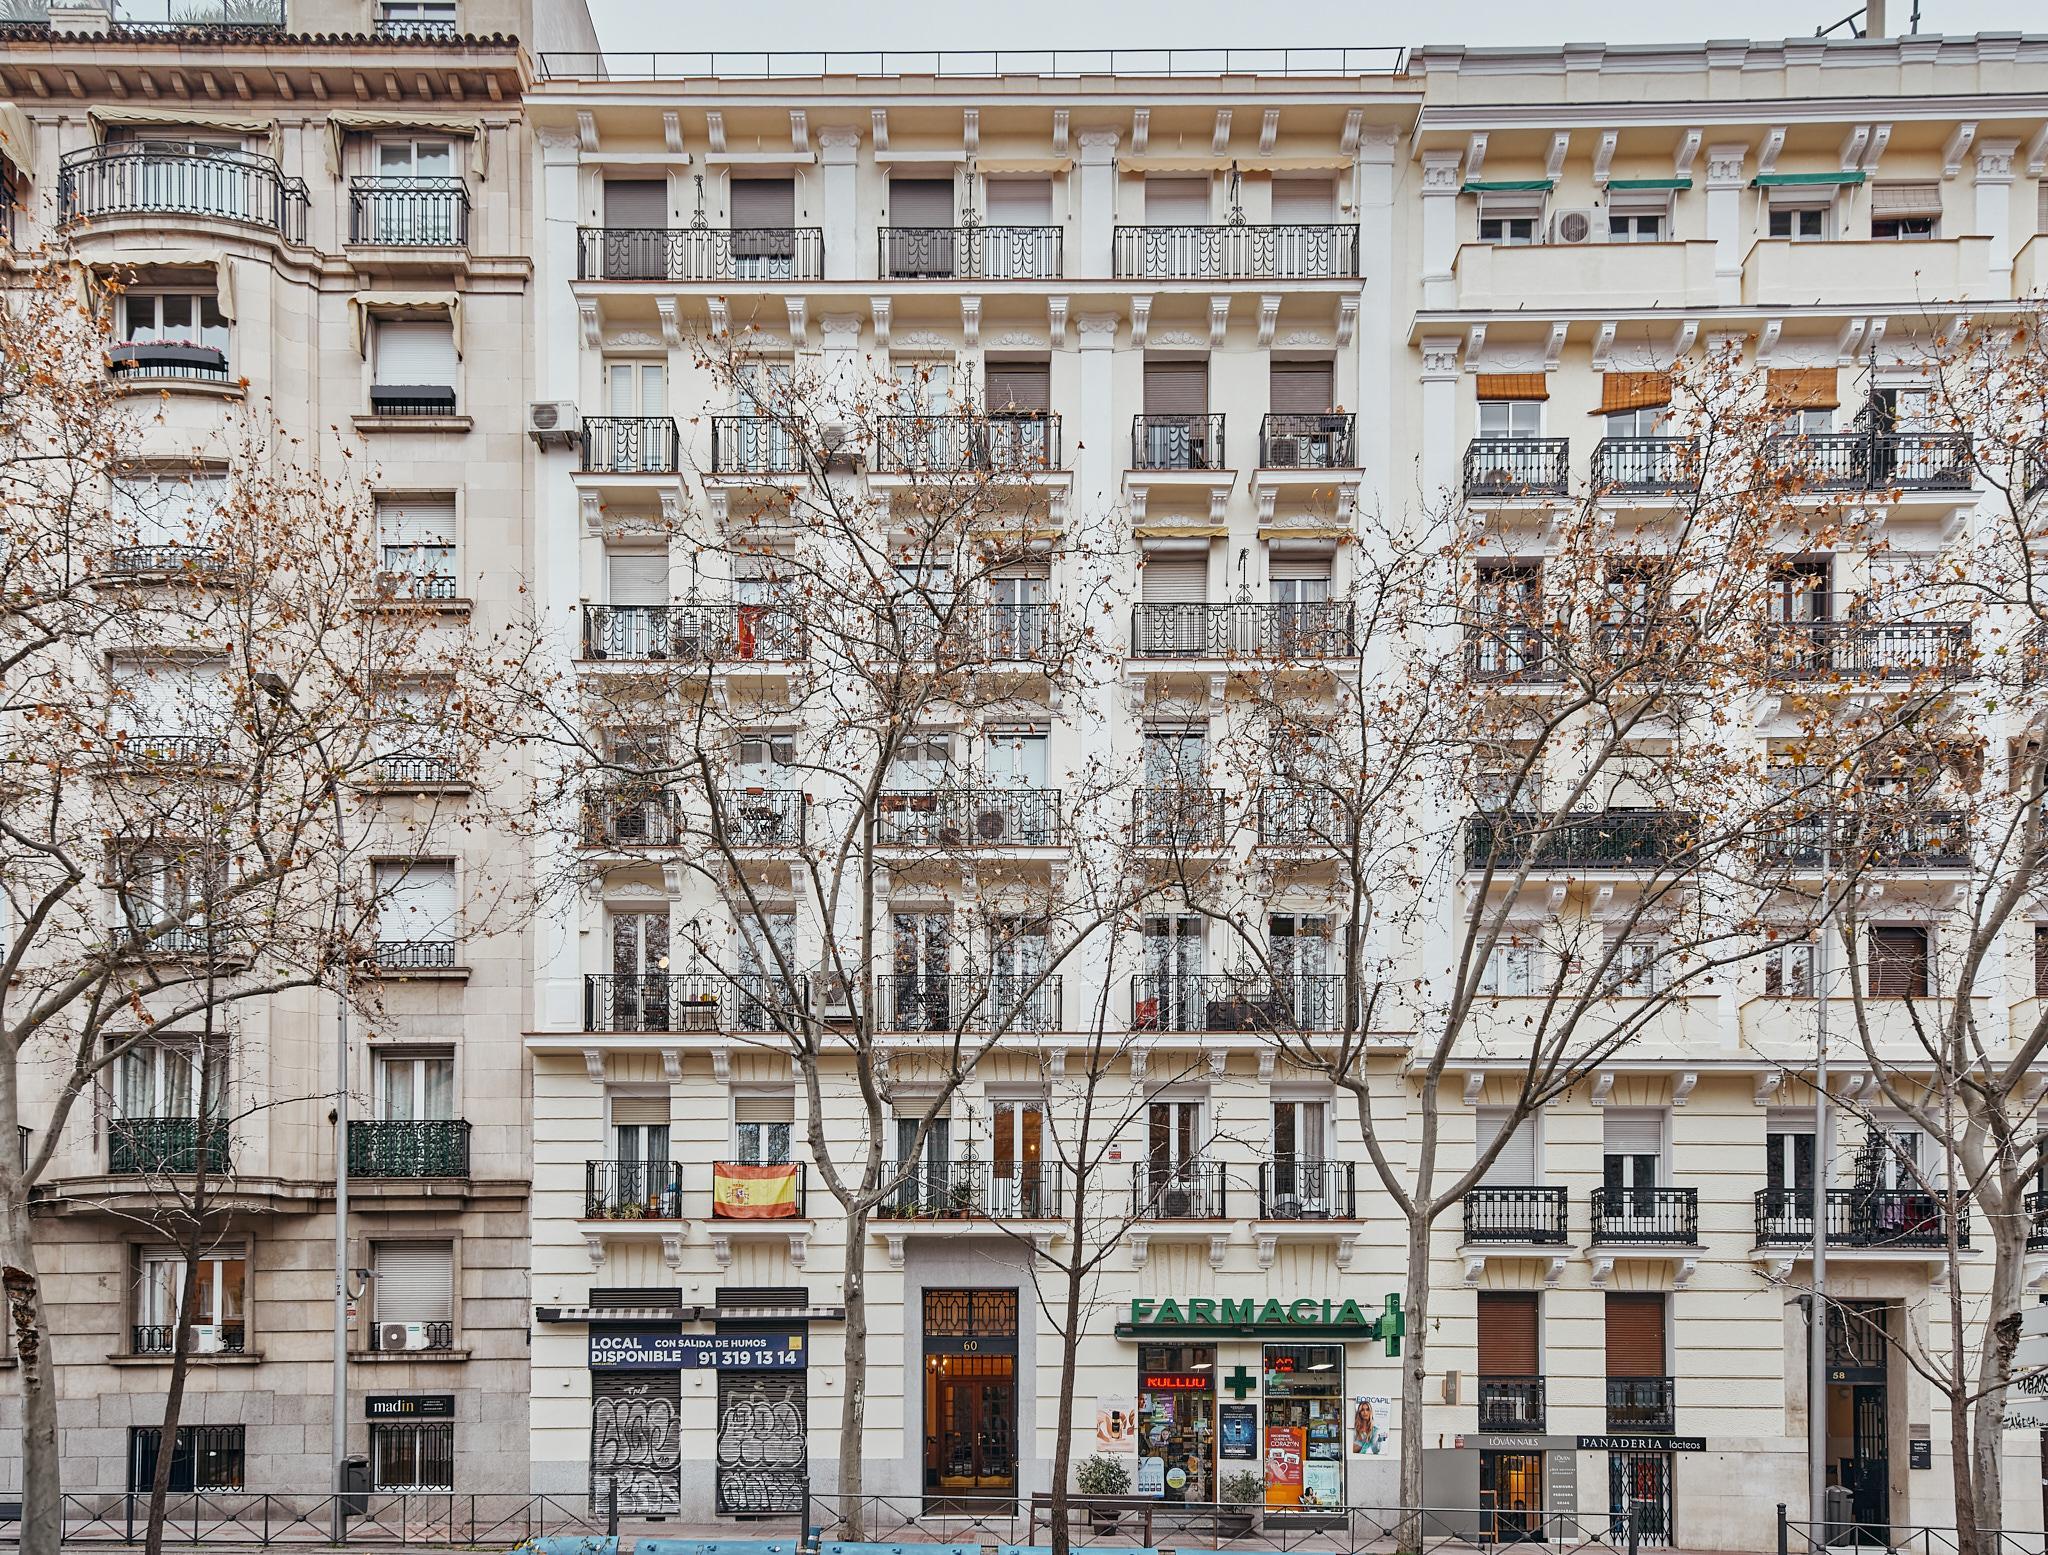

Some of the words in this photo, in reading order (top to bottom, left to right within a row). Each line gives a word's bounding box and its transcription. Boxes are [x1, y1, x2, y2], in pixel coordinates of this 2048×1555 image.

[1131, 1298, 1367, 1324] FARMACIA
[592, 1337, 642, 1349] LOCAL
[655, 1339, 676, 1348] CON
[678, 1339, 711, 1348] SALIDA
[715, 1340, 729, 1348] DE
[731, 1339, 767, 1347] HUMOS
[963, 1340, 978, 1351] 60
[592, 1350, 682, 1363] DISPONIBLE
[698, 1351, 717, 1365] 91
[722, 1351, 751, 1365] 319
[755, 1351, 773, 1365] 13
[777, 1350, 797, 1365] 14
[1832, 1371, 1845, 1380] 58
[373, 1399, 414, 1412] madin
[1517, 1438, 1539, 1446] NAILS
[1582, 1438, 1662, 1449] PANADERÍA
[1669, 1440, 1701, 1450] lácteos
